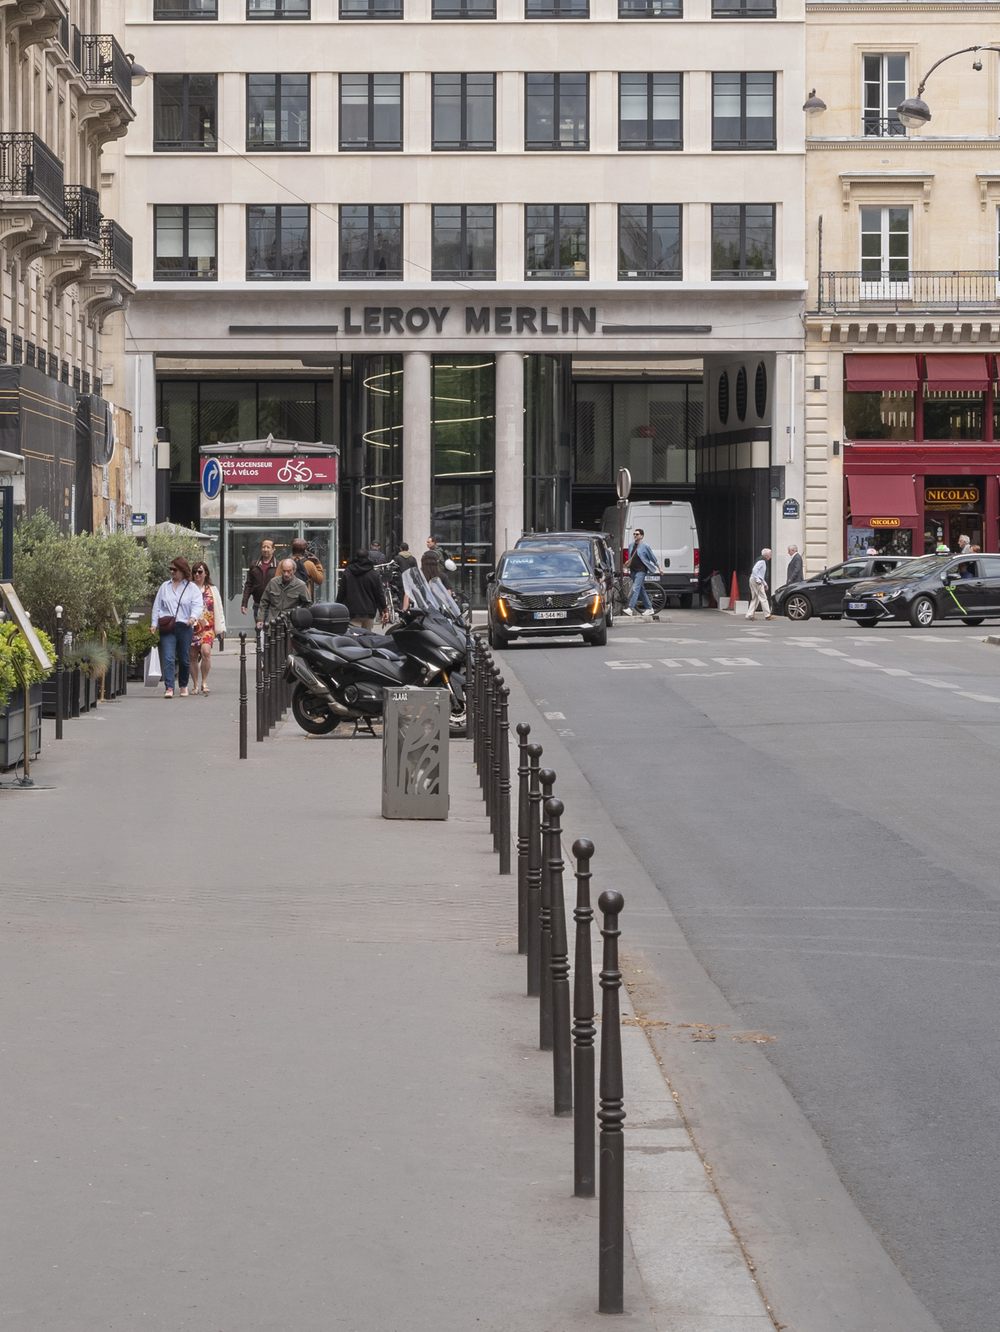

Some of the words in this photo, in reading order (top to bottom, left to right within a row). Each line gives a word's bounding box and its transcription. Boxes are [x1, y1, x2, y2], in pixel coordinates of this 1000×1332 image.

[344, 306, 450, 333] LEROY
[465, 306, 597, 333] MERLIN
[219, 460, 235, 468] CCÈS
[928, 490, 976, 500] NICOLAS
